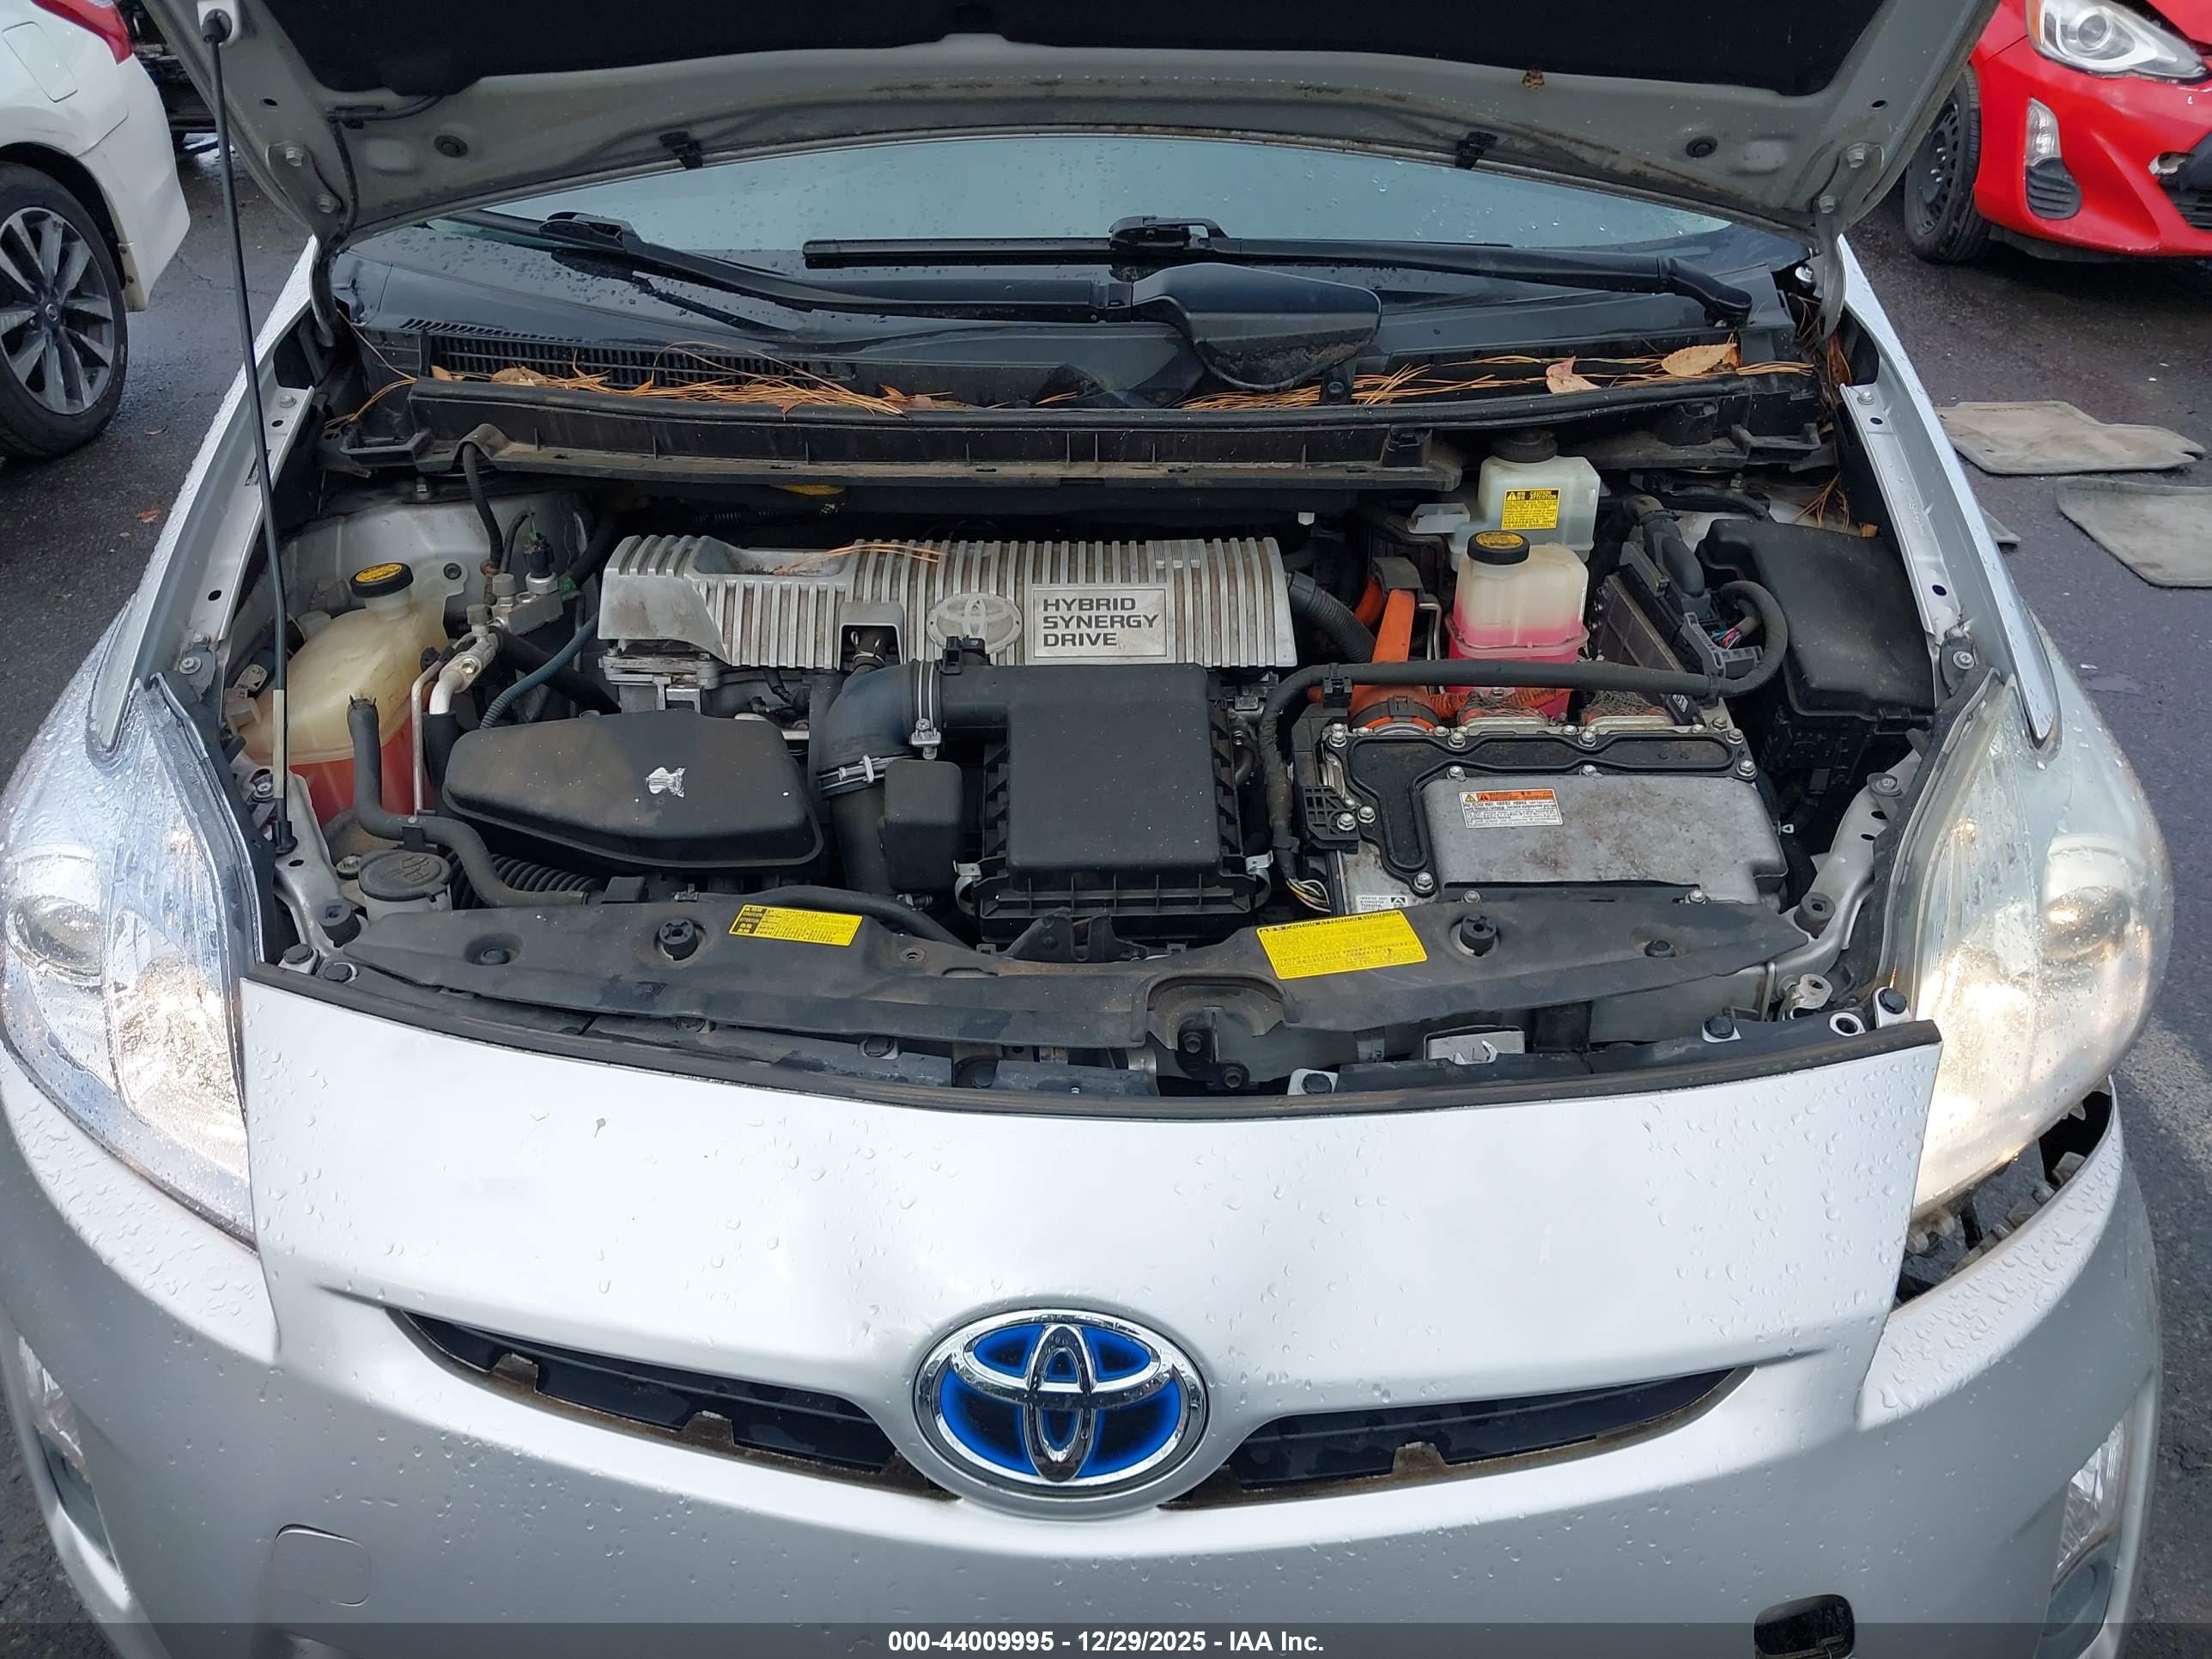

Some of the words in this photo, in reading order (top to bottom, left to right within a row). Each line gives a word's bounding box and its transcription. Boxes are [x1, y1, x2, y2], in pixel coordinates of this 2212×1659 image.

[1043, 598, 1136, 611] HYBRID
[1043, 614, 1158, 629] SYNERGY
[1043, 632, 1117, 647] DRIVE
